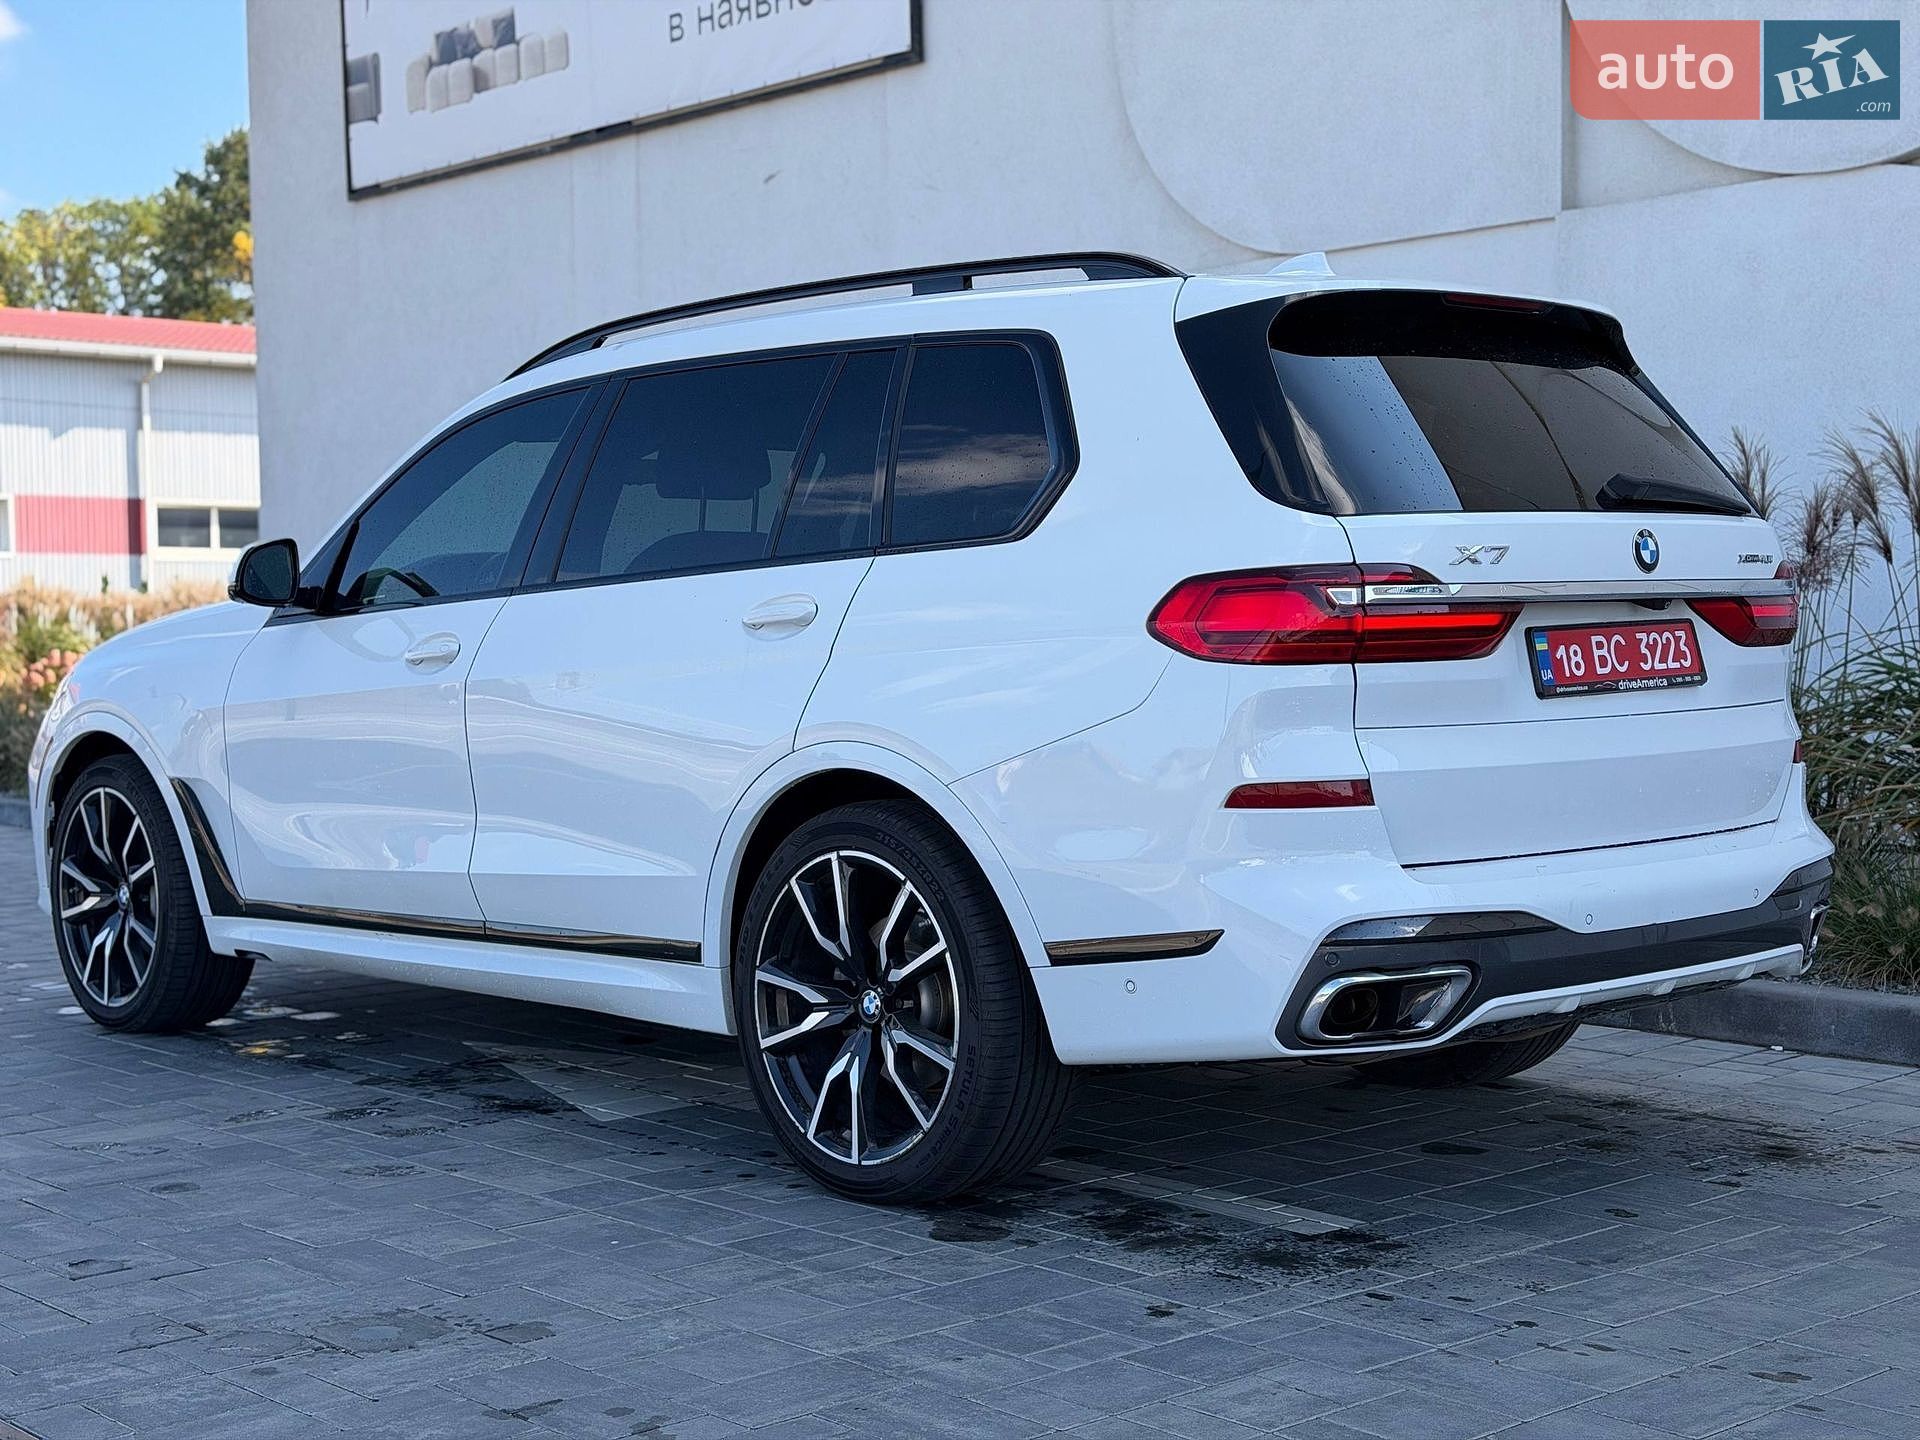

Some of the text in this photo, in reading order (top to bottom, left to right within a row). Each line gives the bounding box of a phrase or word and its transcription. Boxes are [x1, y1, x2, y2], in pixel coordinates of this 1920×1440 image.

[669, 0, 834, 43] в наяв
[1449, 545, 1510, 566] X7
[1556, 630, 1692, 677] 18 BC 3223
[1541, 669, 1554, 681] UA
[1618, 676, 1668, 690] driveAmerica
